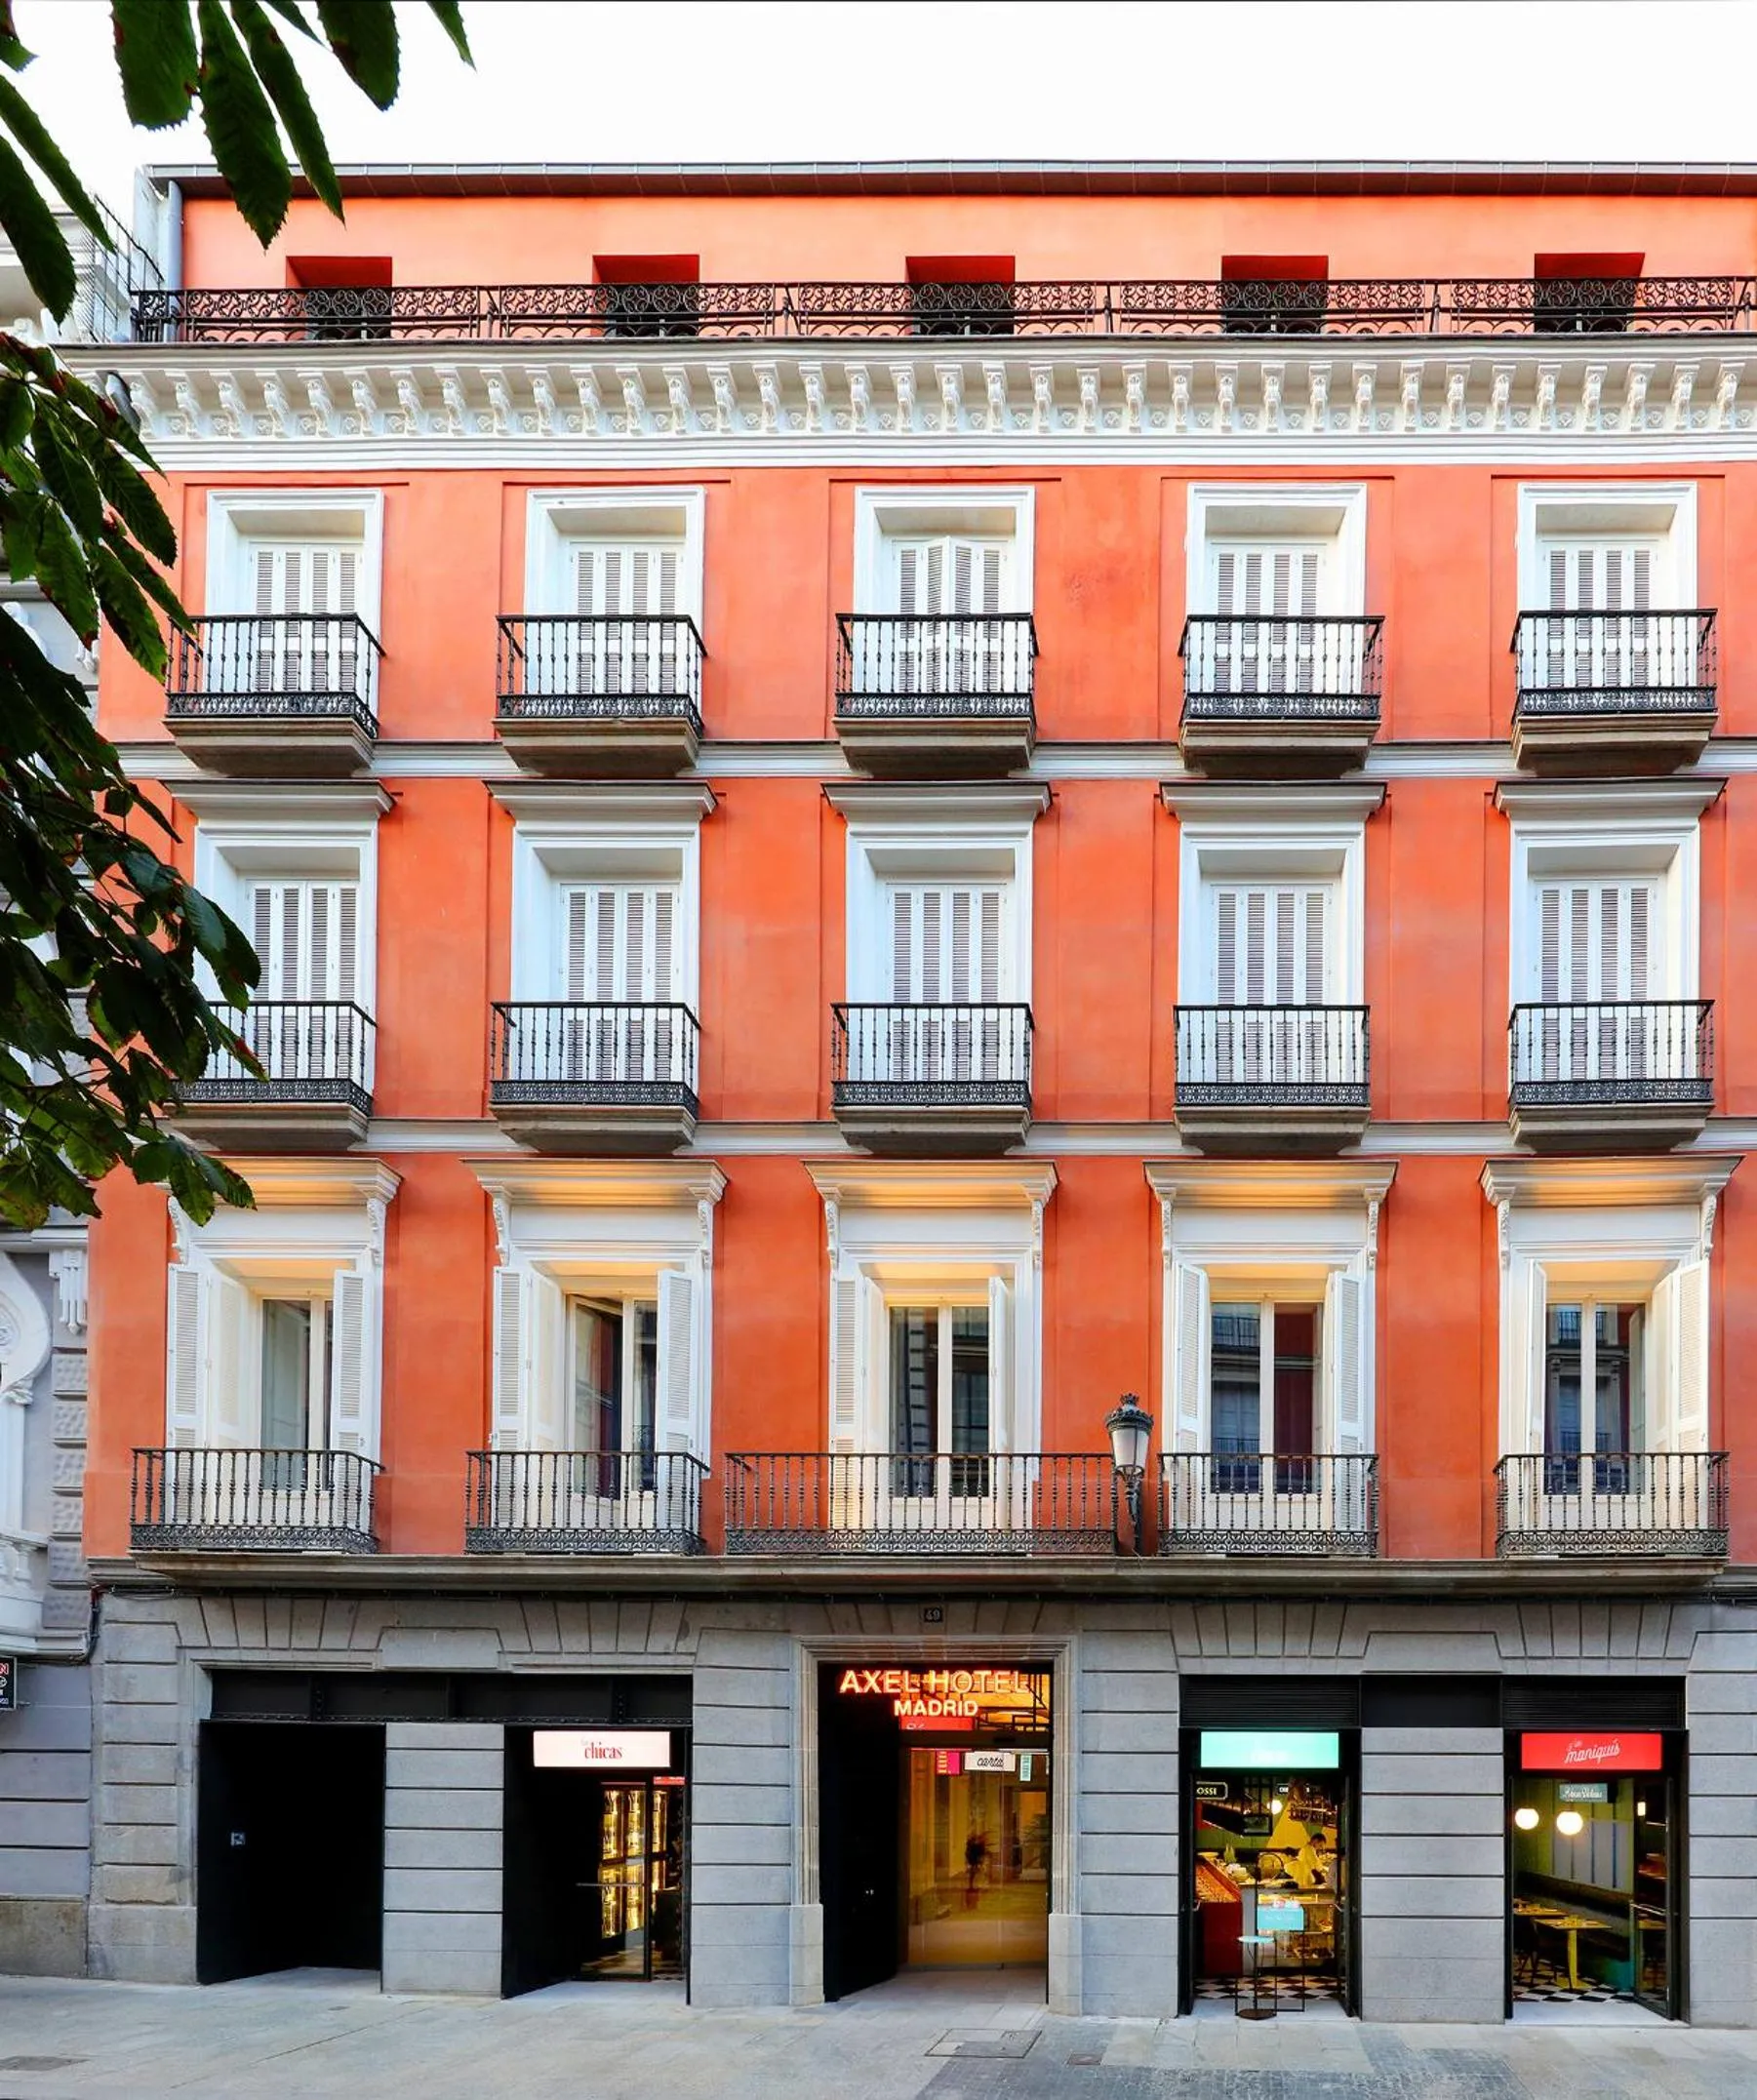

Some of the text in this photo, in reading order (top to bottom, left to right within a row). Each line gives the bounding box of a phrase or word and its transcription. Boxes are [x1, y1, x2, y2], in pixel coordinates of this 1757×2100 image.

[839, 1670, 1030, 1693] AXEL HOTEL
[894, 1699, 978, 1717] MADRID
[584, 1742, 622, 1759] chicas
